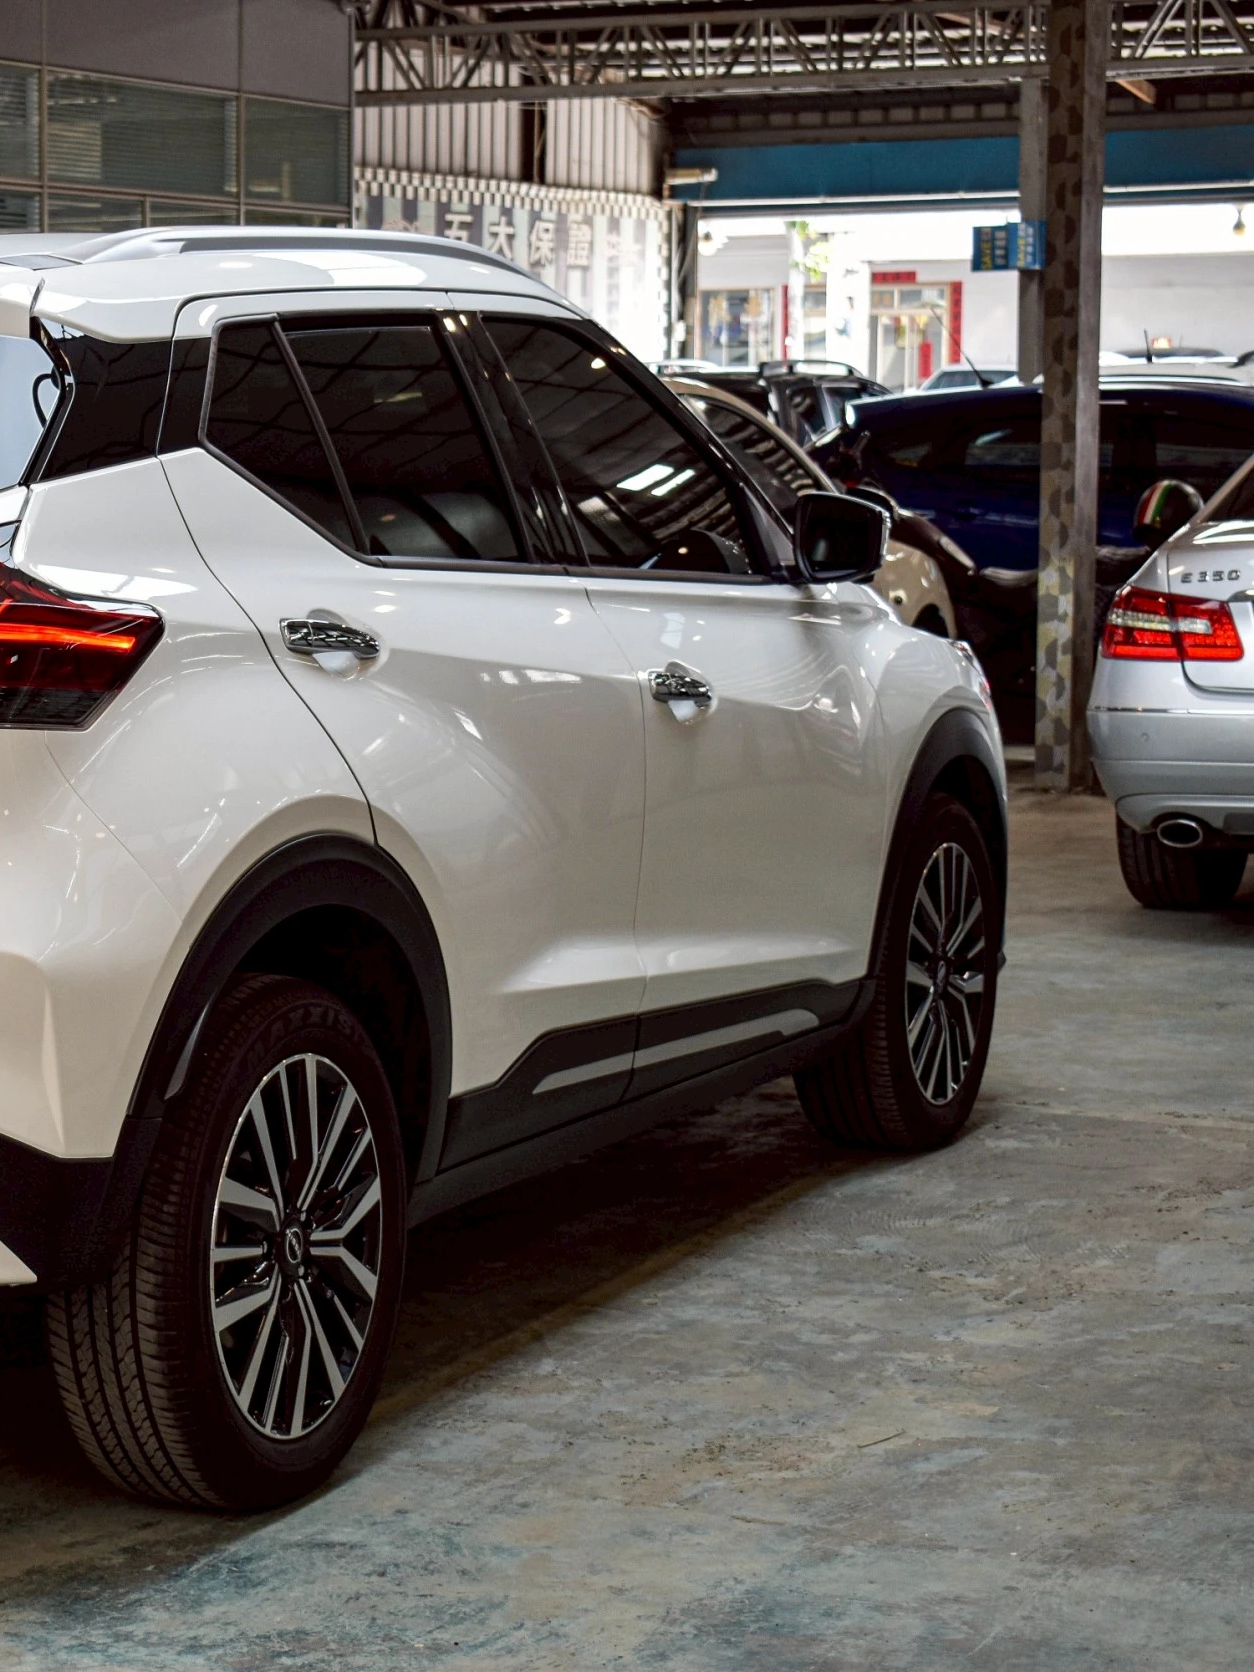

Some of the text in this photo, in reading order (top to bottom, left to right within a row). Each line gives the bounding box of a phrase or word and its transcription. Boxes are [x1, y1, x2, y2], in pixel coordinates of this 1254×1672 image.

[444, 213, 592, 268] 五大保證
[1180, 569, 1241, 583] E 350
